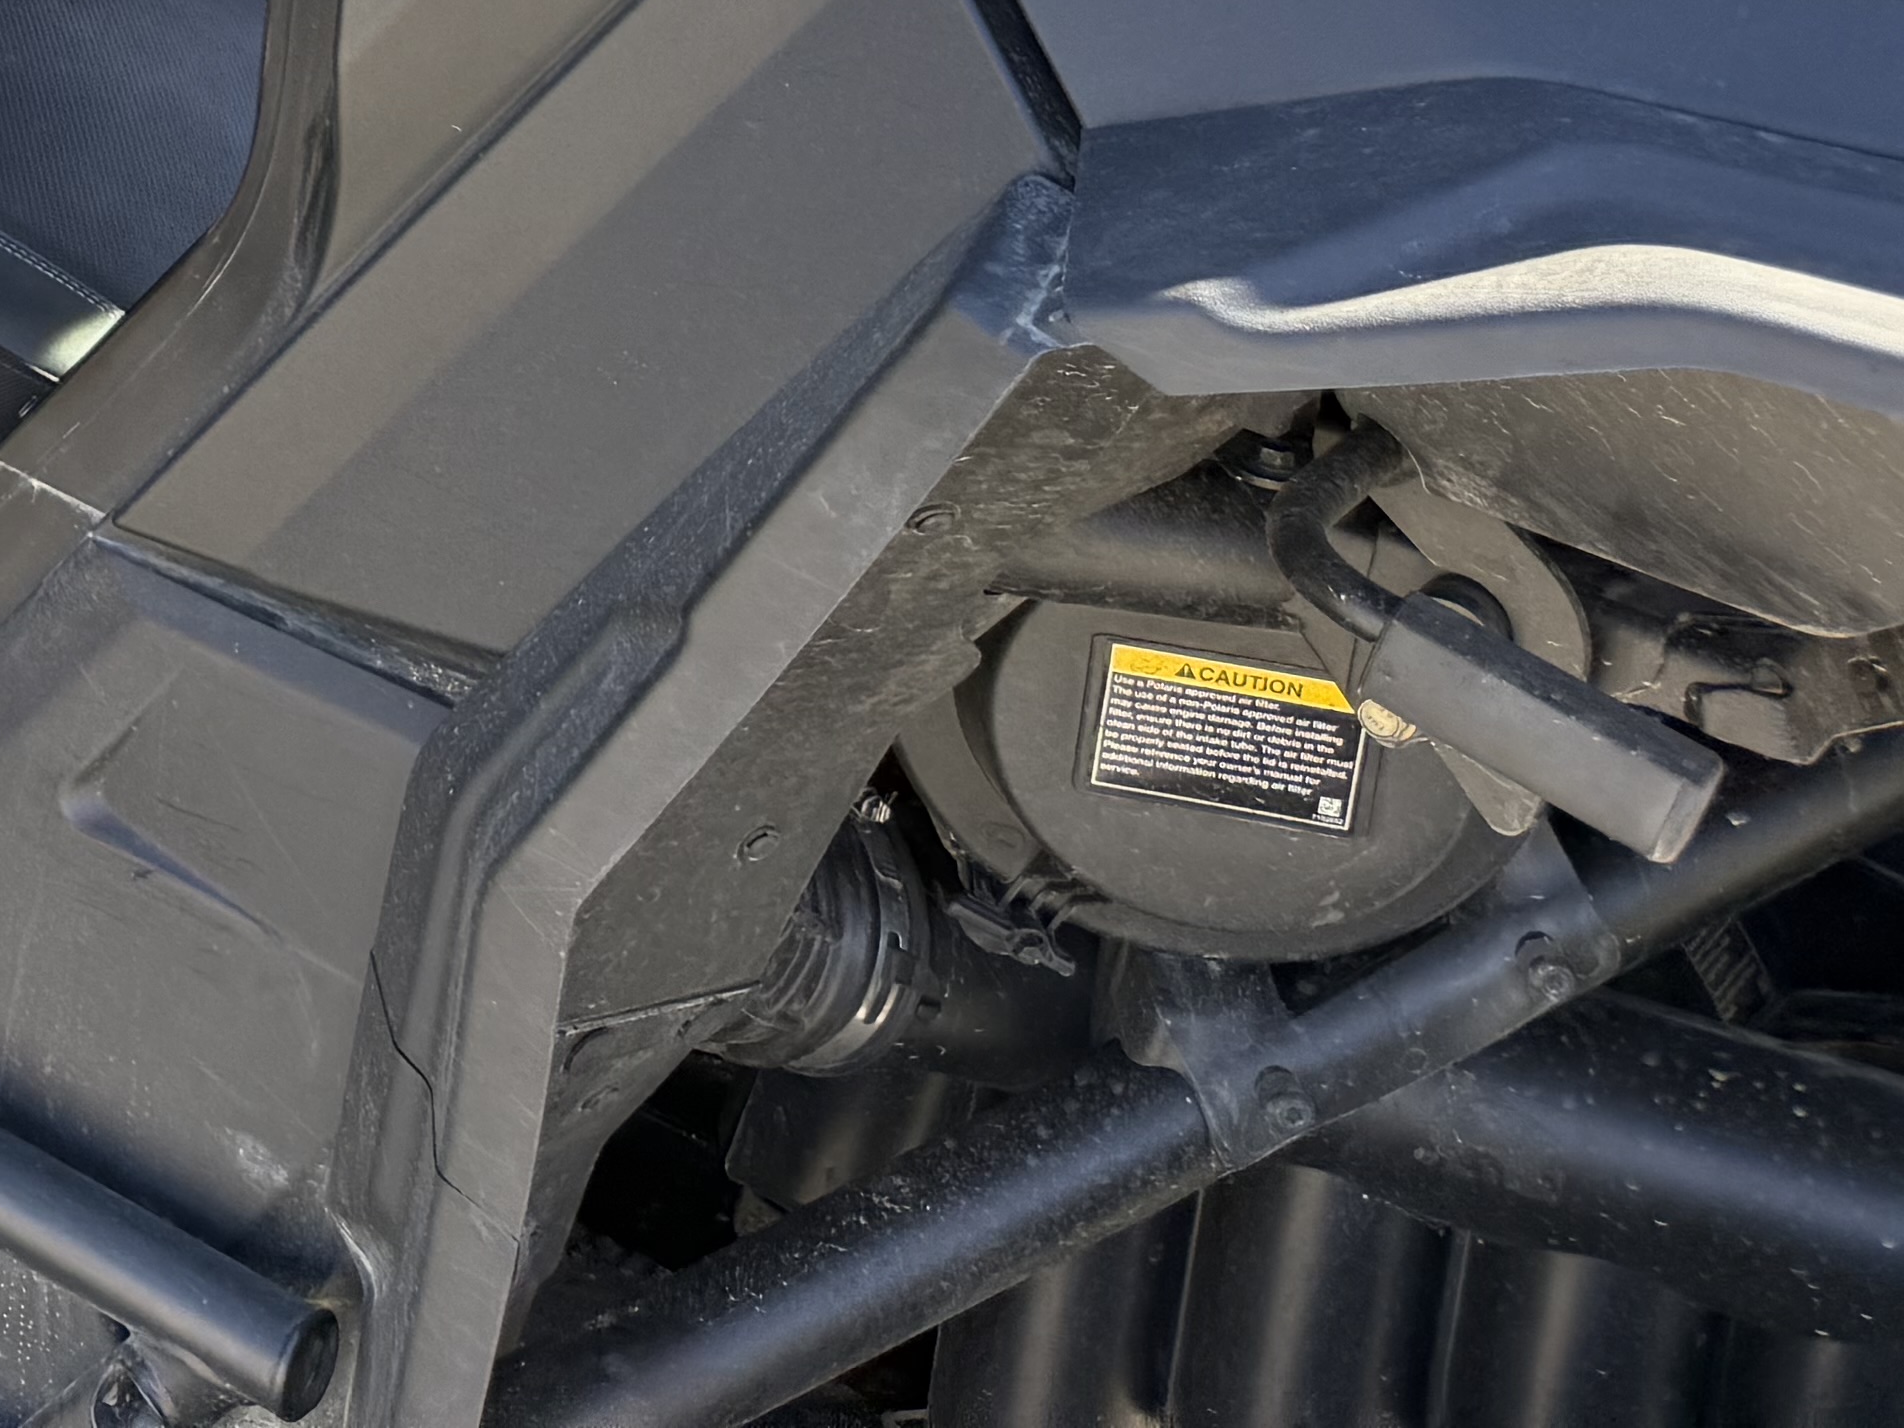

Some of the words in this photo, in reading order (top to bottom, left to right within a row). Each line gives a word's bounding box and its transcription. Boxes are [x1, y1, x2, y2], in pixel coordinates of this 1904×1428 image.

[1113, 674, 1134, 685] Use
[1146, 680, 1182, 693] Polaris
[1185, 687, 1235, 705] approved
[1238, 696, 1253, 706] air
[1255, 699, 1280, 710] filter.
[1199, 666, 1303, 697] CAUTION
[1108, 707, 1133, 718] filter,
[1136, 713, 1171, 725] ensure
[1175, 718, 1201, 730] there
[1204, 724, 1214, 733] is
[1217, 727, 1230, 735] no
[1233, 729, 1251, 739] dirt
[1254, 734, 1264, 742] or
[1267, 735, 1301, 748] debris
[1304, 742, 1316, 751] in
[1319, 744, 1334, 754] the
[1110, 697, 1131, 709] may
[1134, 702, 1166, 713] cause
[1169, 706, 1205, 722] engine
[1207, 713, 1252, 730] damage.
[1256, 722, 1292, 735] Before
[1294, 729, 1343, 747] installing
[1112, 685, 1132, 696] The
[1137, 691, 1153, 700] use
[1156, 693, 1166, 702] of
[1178, 697, 1239, 715] non-Polaris
[1242, 708, 1293, 726] approved
[1295, 717, 1310, 727] air
[1312, 720, 1338, 732] filter
[1103, 739, 1138, 753] Please
[1140, 746, 1190, 762] reference
[1193, 757, 1216, 769] your
[1263, 768, 1301, 783] manual
[1305, 776, 1319, 786] for
[1104, 728, 1118, 738] be
[1120, 731, 1164, 749] properly
[1167, 740, 1203, 753] seated
[1205, 747, 1239, 760] before
[1242, 753, 1259, 764] the
[1263, 757, 1275, 767] lid
[1278, 760, 1287, 769] is
[1290, 762, 1347, 780] reinstalled.
[1106, 717, 1135, 730] clean
[1138, 723, 1159, 734] side
[1162, 727, 1173, 737] of
[1176, 730, 1193, 740] the
[1195, 733, 1227, 746] intake
[1230, 740, 1257, 752] tube.
[1261, 745, 1280, 756] The
[1283, 749, 1297, 759] air
[1300, 752, 1323, 764] filter
[1326, 757, 1353, 769] must
[1100, 761, 1140, 775] service.
[1101, 750, 1153, 766] additional
[1156, 760, 1215, 778] information
[1217, 771, 1268, 790] regarding
[1271, 781, 1284, 791] air
[1287, 784, 1312, 796] filter
